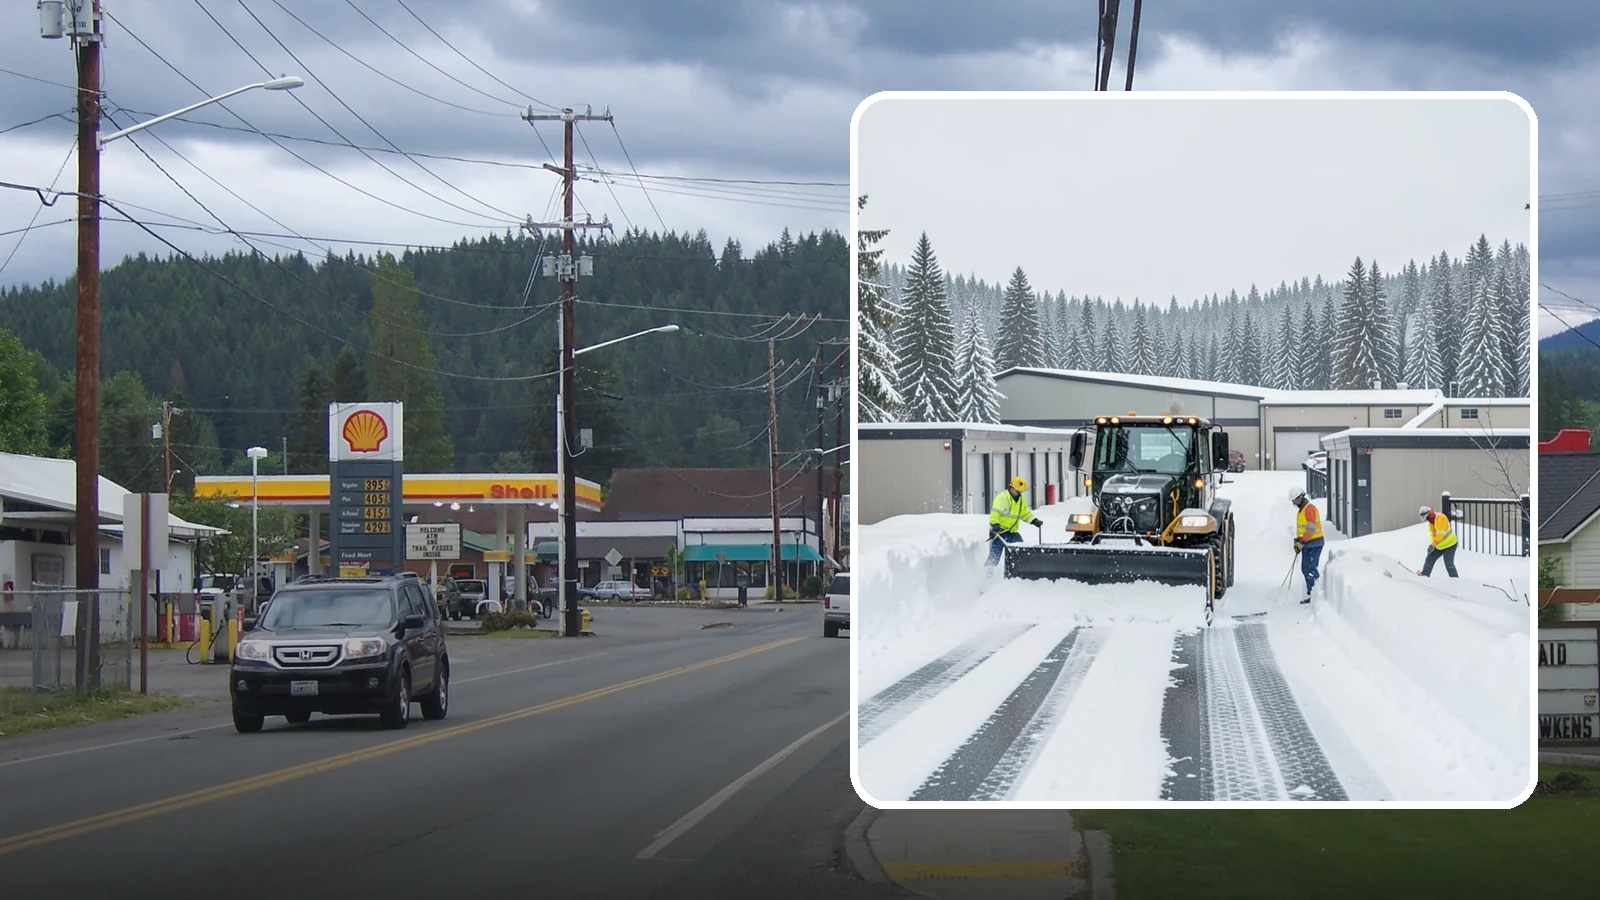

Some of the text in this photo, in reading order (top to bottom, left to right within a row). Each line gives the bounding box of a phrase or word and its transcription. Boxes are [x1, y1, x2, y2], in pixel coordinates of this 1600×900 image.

[366, 480, 384, 490] 395
[490, 484, 547, 499] Shell
[366, 494, 384, 504] 405
[366, 508, 384, 518] 415
[366, 522, 384, 532] 429
